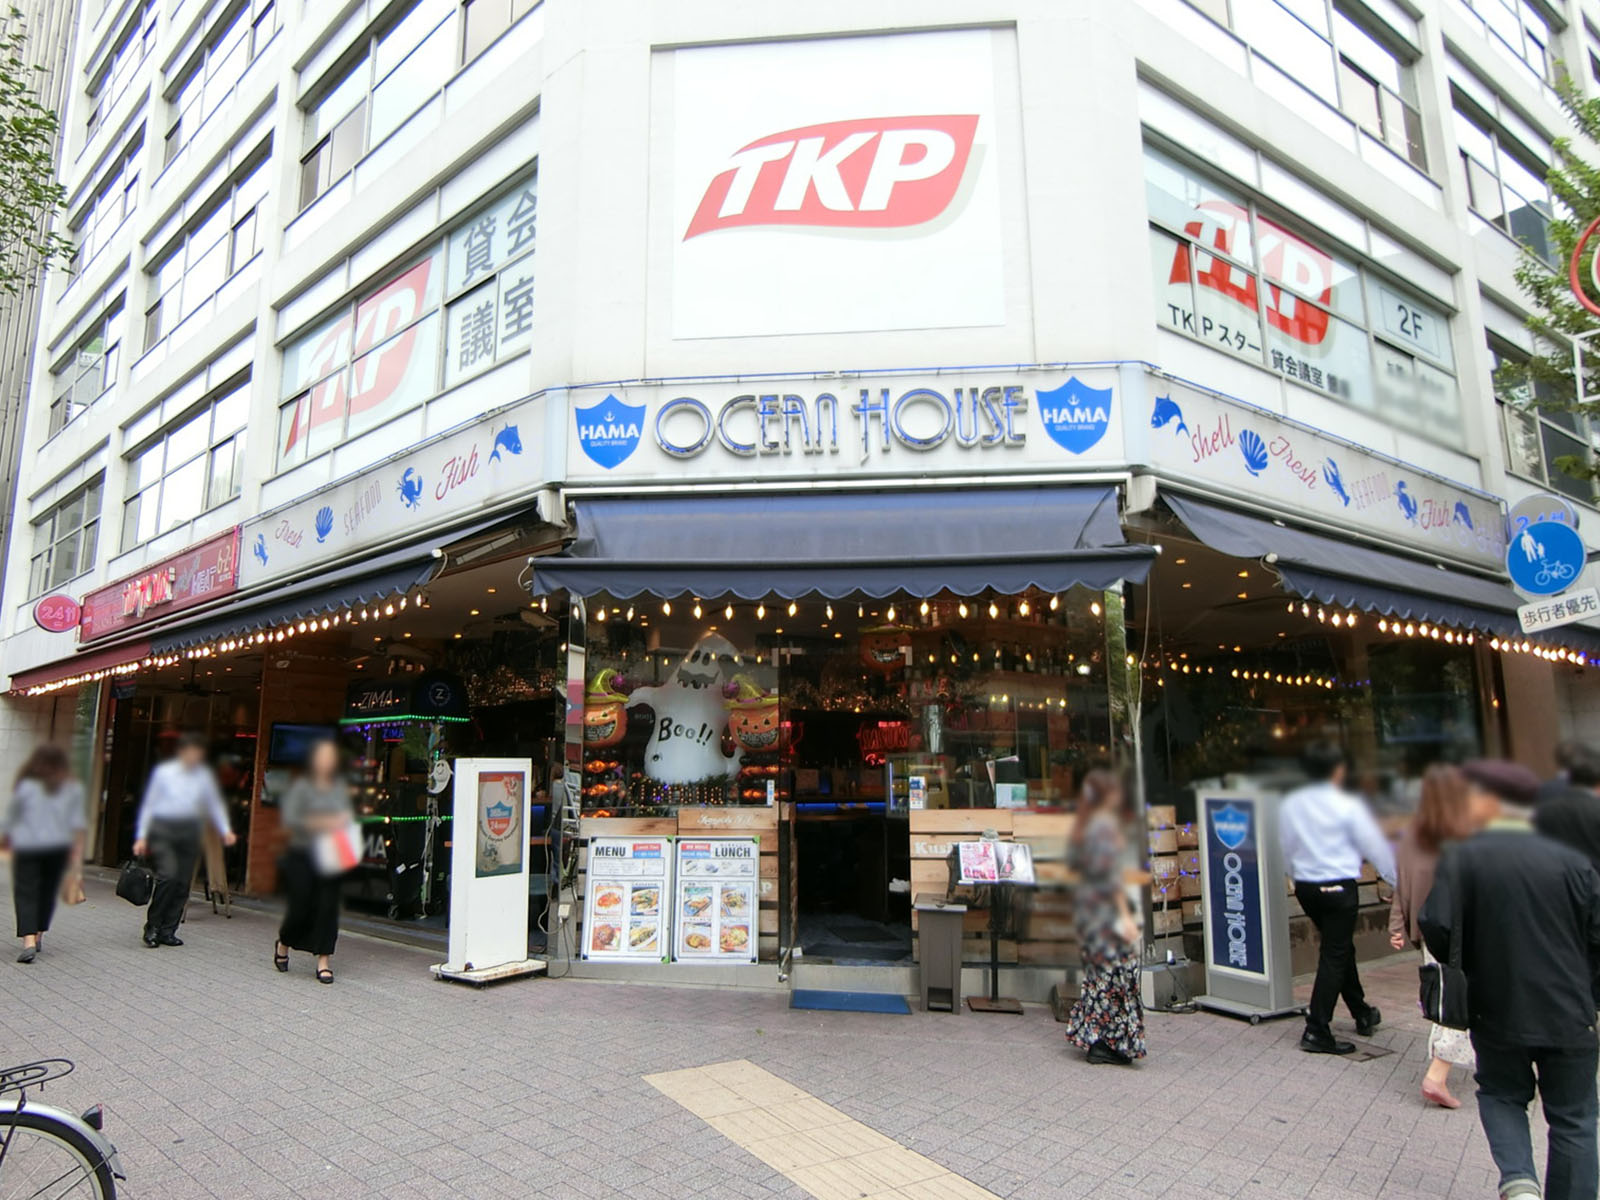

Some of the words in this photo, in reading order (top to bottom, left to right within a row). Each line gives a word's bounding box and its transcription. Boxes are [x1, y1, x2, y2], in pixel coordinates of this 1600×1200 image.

[718, 128, 956, 219] TKP
[1195, 208, 1324, 321] TKP
[1397, 304, 1424, 340] 2F
[1270, 349, 1324, 389] 貸会議室
[580, 423, 640, 440] HAMA
[653, 392, 840, 460] OCEAN
[851, 385, 1028, 466] HOUSE
[1042, 406, 1108, 424] HAMA
[274, 519, 304, 549] Fresh
[343, 479, 383, 537] SEAFOOD
[434, 443, 480, 501] Fish
[1269, 436, 1318, 490] Fresh
[1420, 498, 1451, 530] Fish
[1523, 595, 1598, 628] 歩行者優先
[360, 689, 393, 710] ZIMA
[382, 728, 405, 739] ZIMA
[658, 717, 714, 746] Boo!!
[595, 846, 626, 857] MENU
[714, 847, 751, 858] LUNCH
